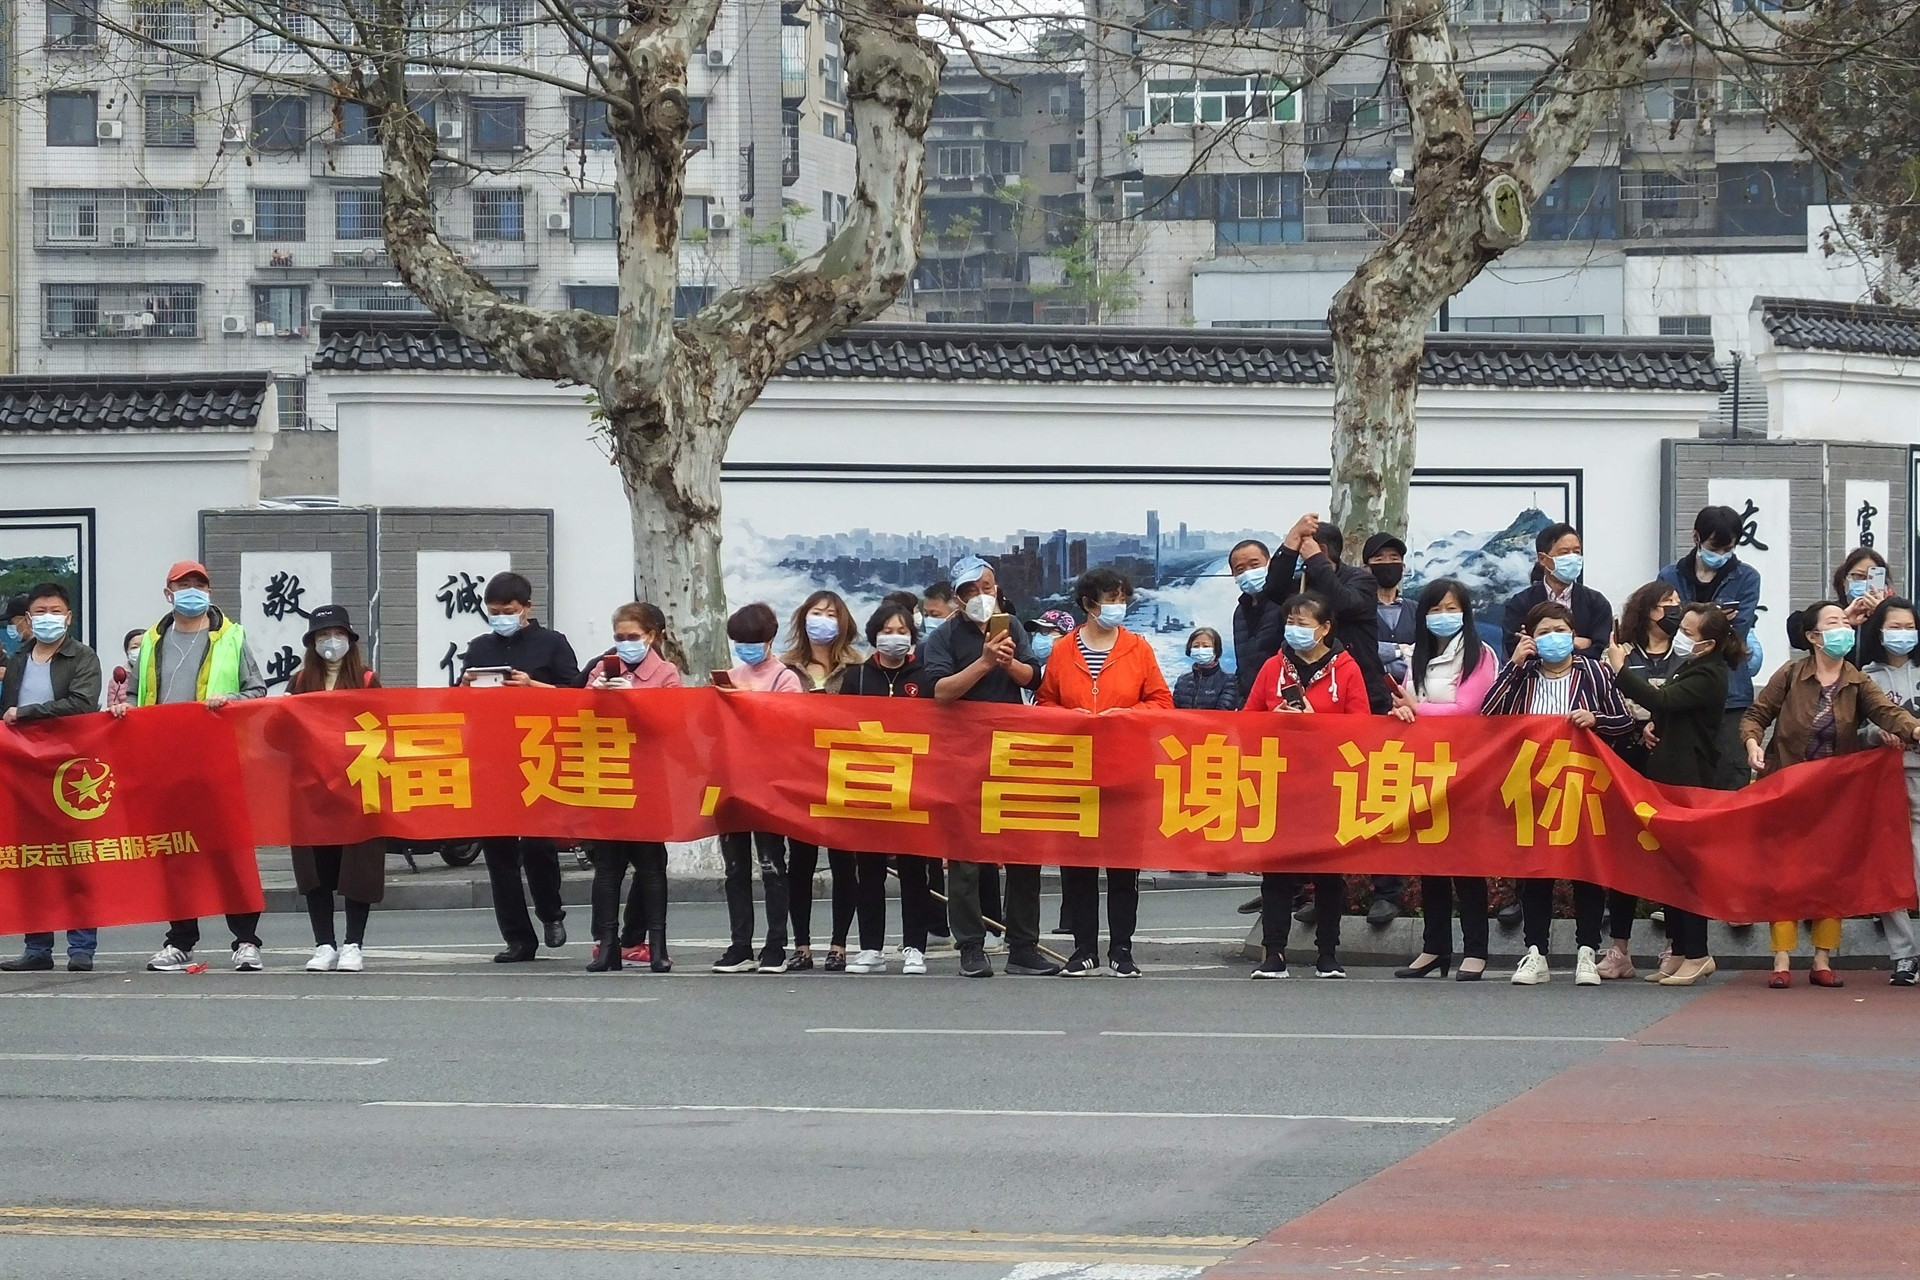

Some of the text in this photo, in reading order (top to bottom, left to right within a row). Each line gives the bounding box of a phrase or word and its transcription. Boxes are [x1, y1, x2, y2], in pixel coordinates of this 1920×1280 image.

[0, 830, 200, 870] 赞友志愿者服务队
